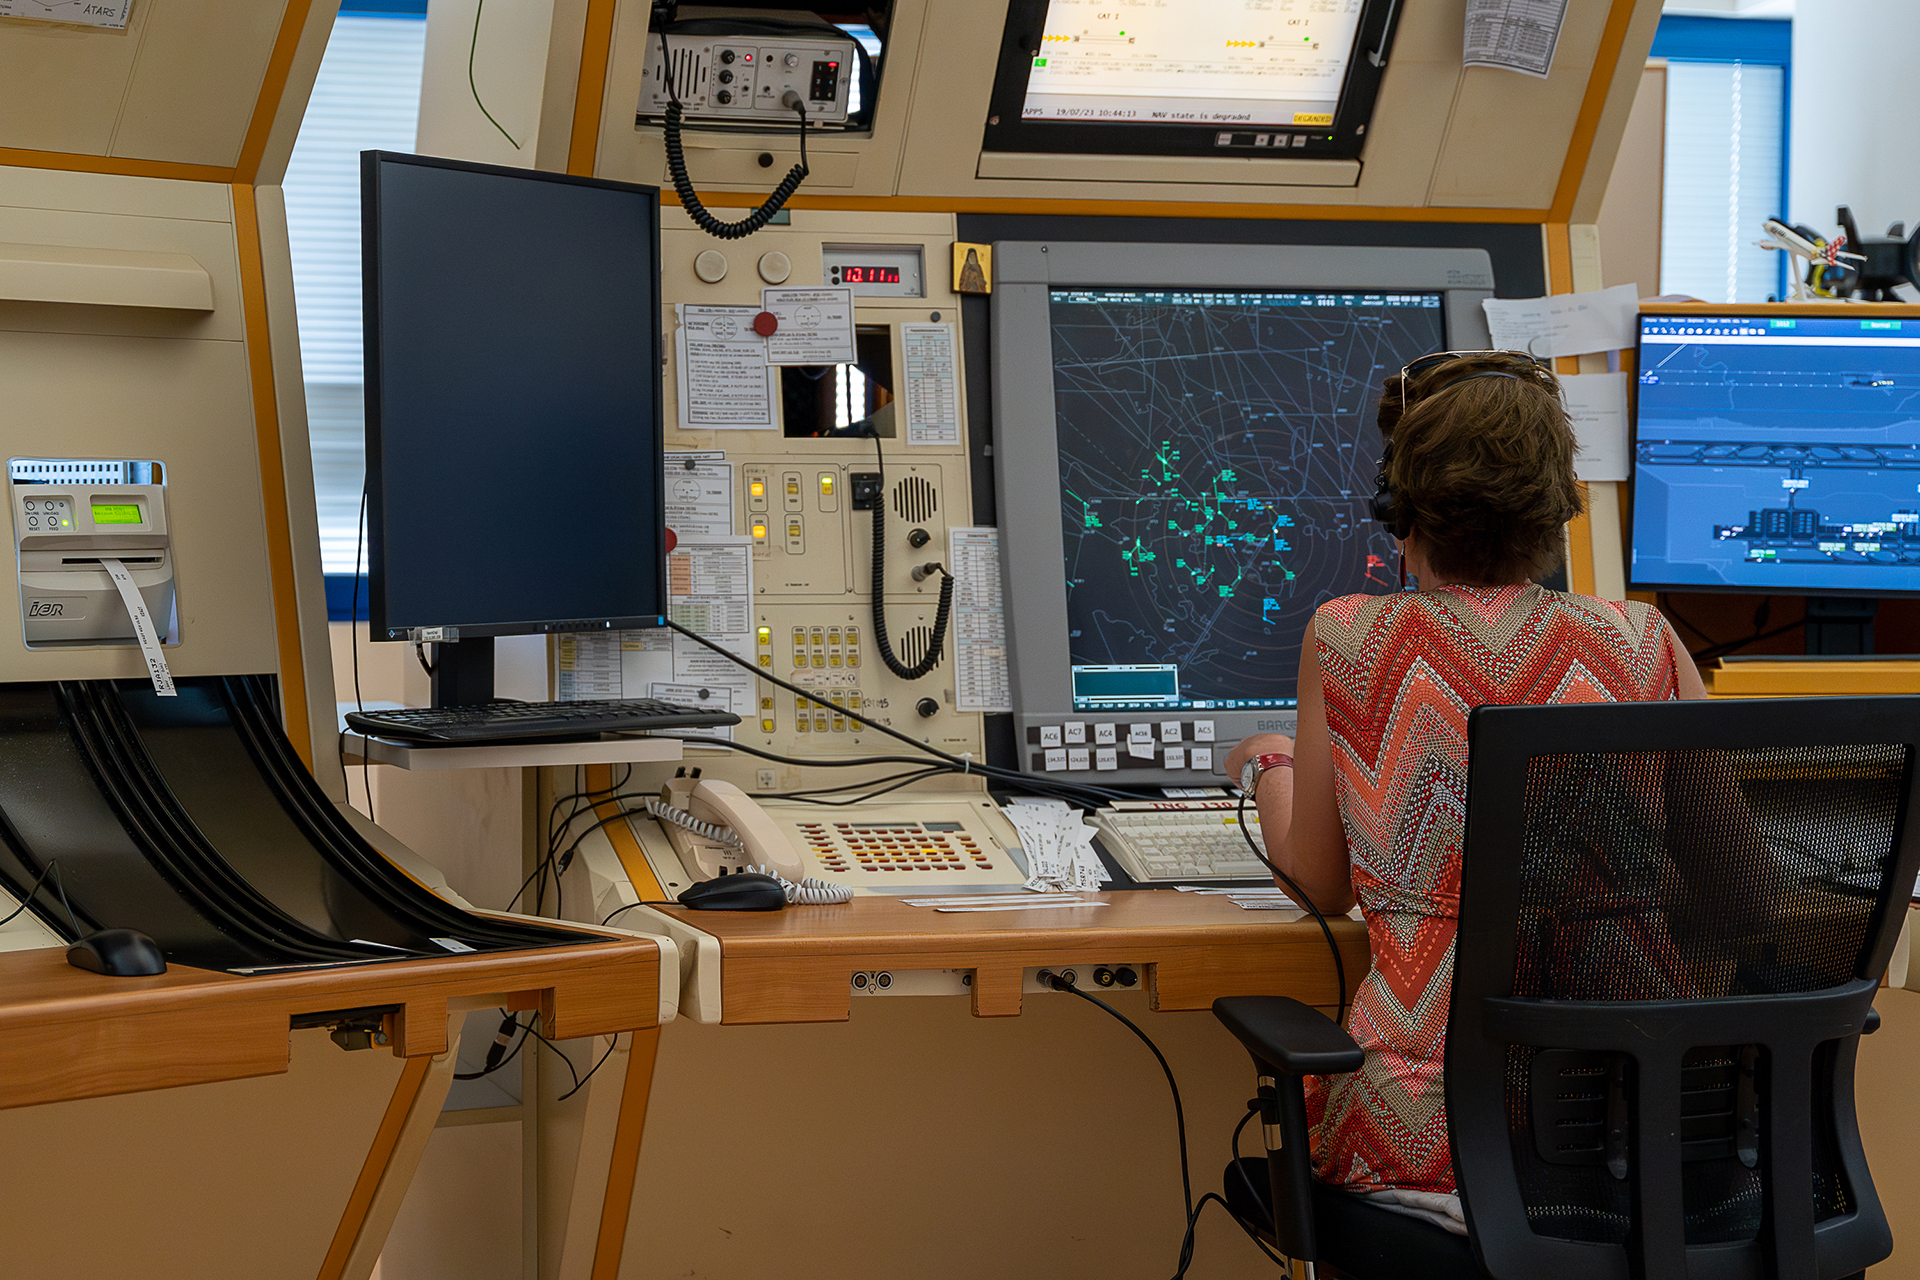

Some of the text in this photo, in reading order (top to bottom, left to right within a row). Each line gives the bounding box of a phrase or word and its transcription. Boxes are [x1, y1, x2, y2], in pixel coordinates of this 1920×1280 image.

[83, 4, 115, 18] ATARS
[1023, 108, 1043, 116] APPS
[1098, 109, 1137, 117] 10:44:13
[1212, 113, 1251, 121] degraded
[1068, 728, 1082, 736] AC7
[1164, 728, 1178, 736] AC2
[1197, 726, 1212, 734] AC5
[1044, 733, 1059, 741] AC6
[1200, 801, 1233, 809] 130
